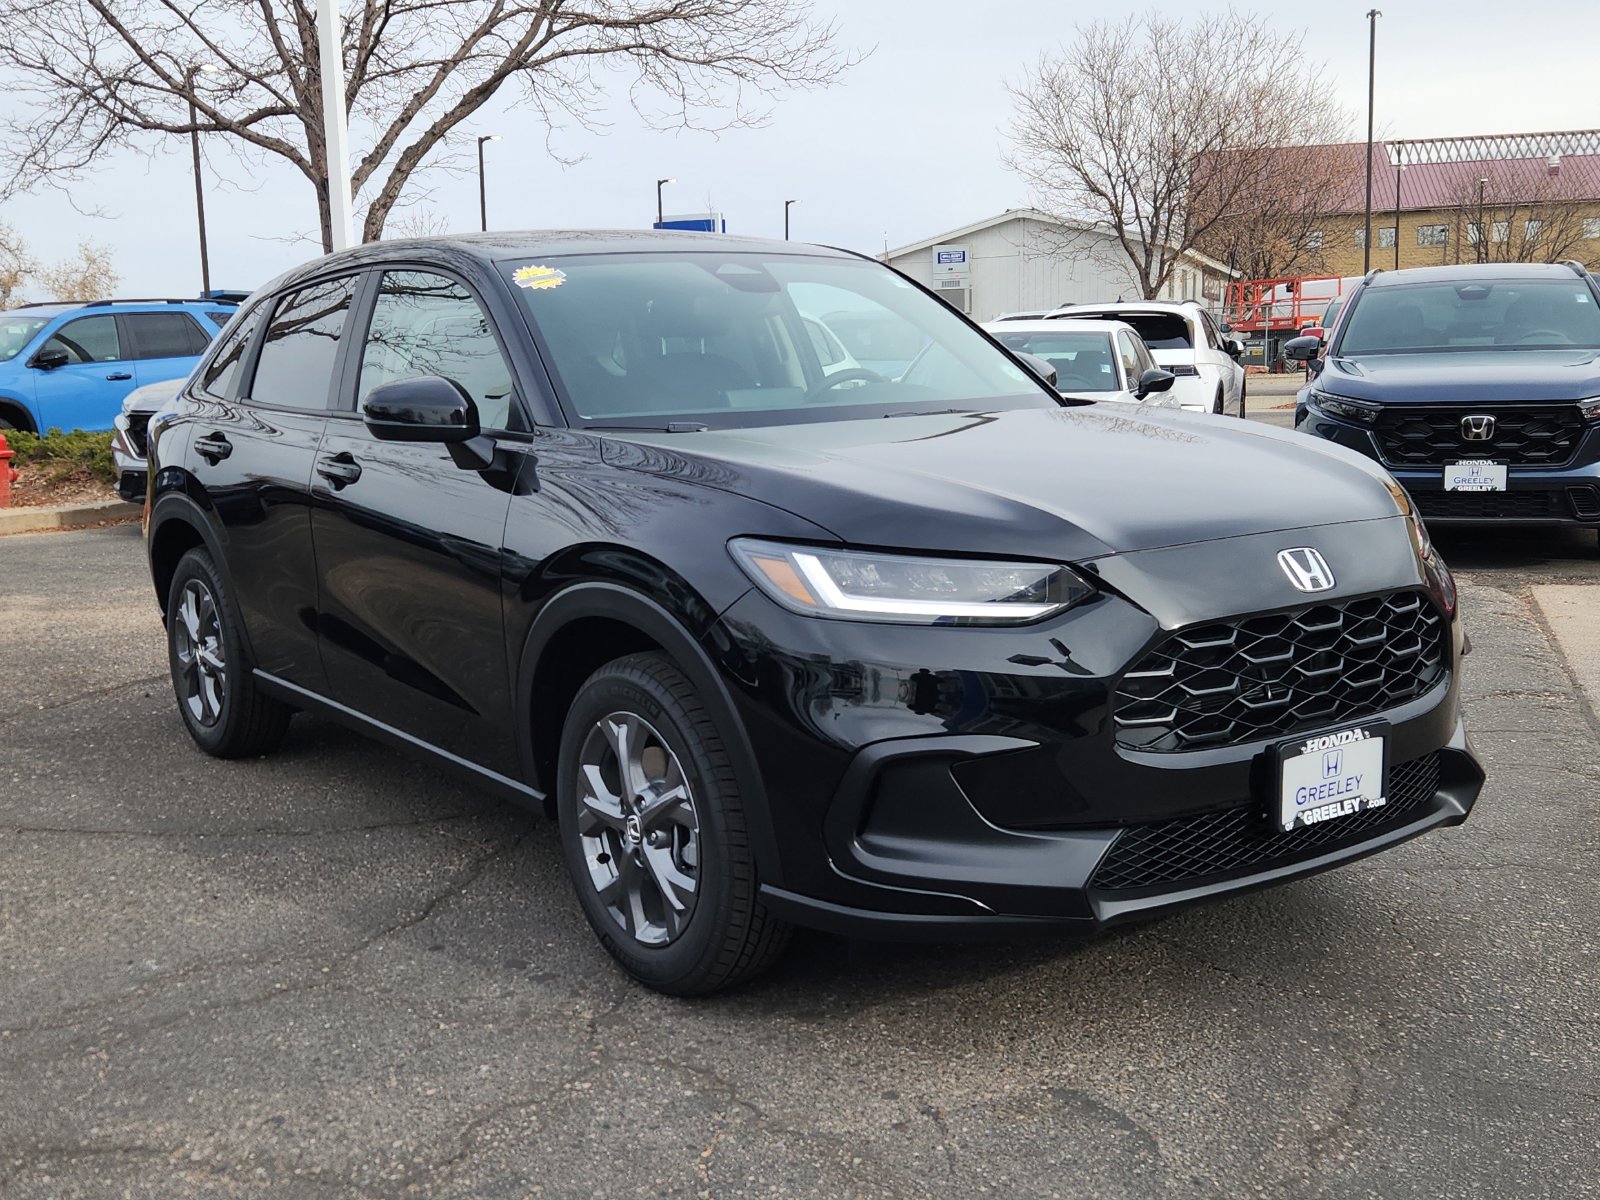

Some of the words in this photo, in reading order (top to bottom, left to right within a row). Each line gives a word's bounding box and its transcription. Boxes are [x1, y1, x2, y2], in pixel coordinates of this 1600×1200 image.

[1305, 728, 1364, 753] HONDA
[1295, 774, 1363, 805] GREELEY
[1303, 797, 1361, 825] GREELEY
